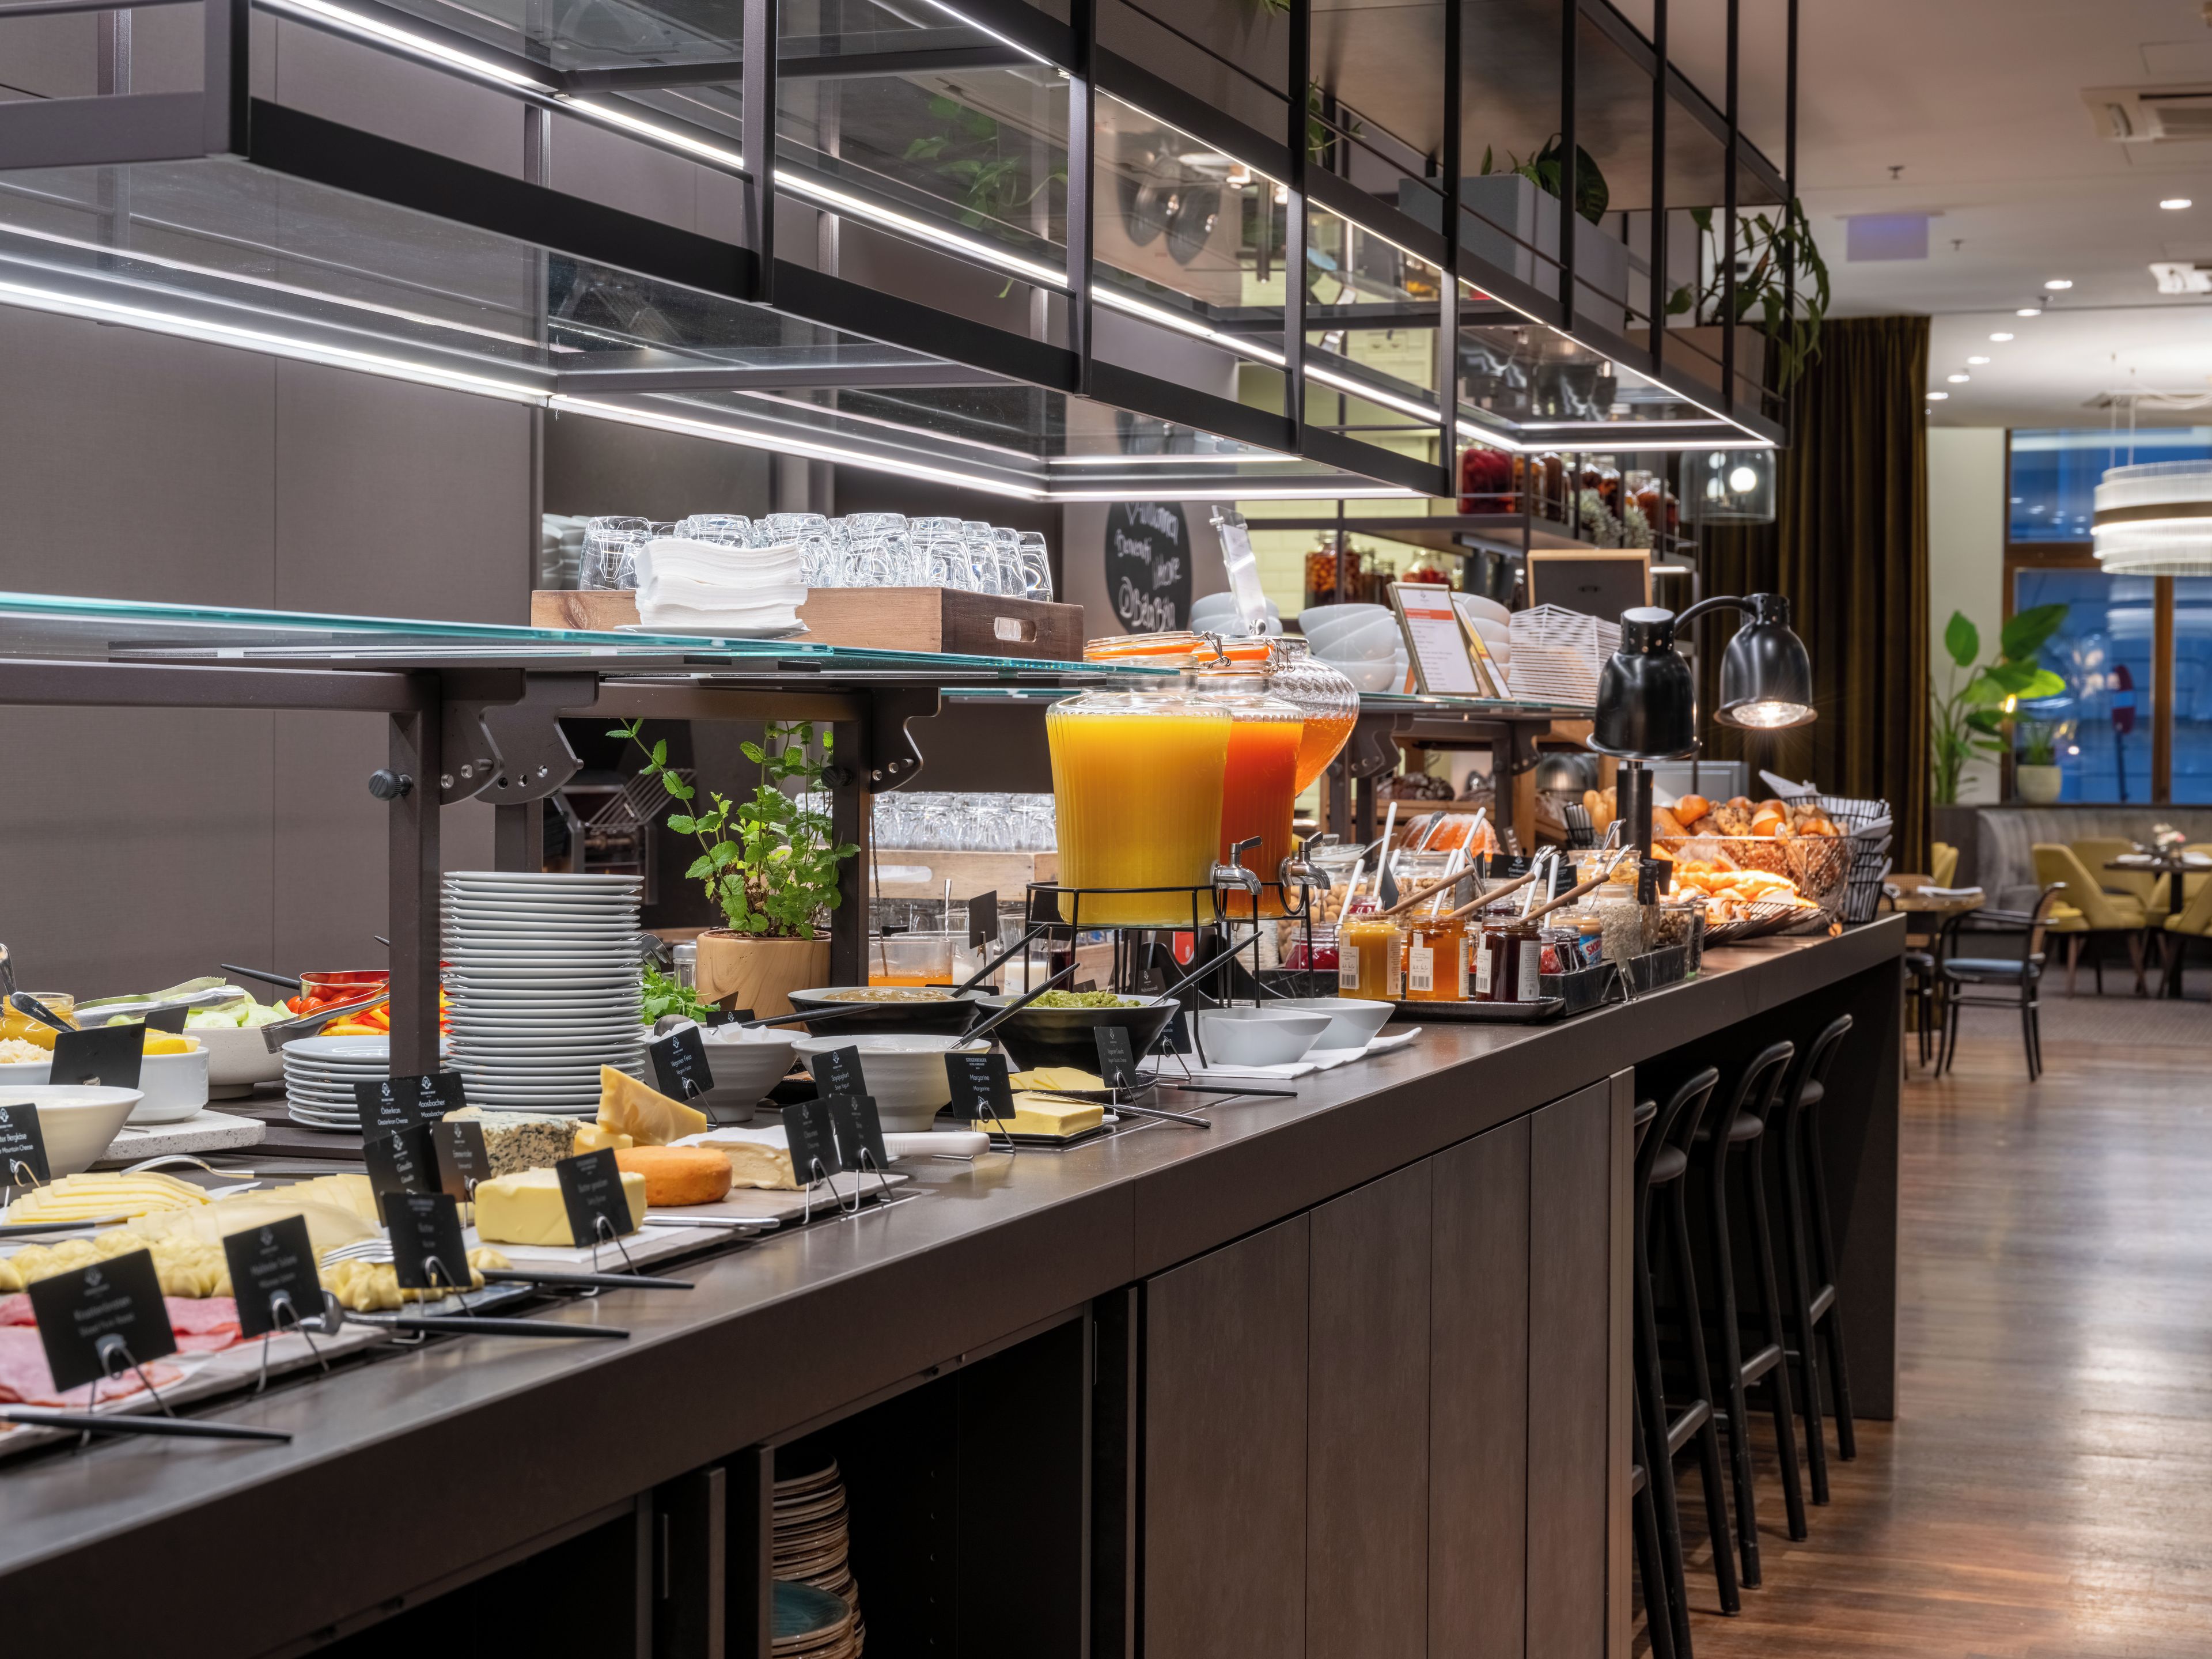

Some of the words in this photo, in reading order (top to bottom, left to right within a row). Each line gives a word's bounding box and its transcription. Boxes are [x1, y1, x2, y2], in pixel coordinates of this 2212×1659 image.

[670, 1058, 684, 1067] Veganer
[684, 1054, 692, 1062] Feta
[380, 1105, 402, 1115] Österkron
[6, 1132, 27, 1143] Bergkäse
[2, 1146, 19, 1154] Mountain
